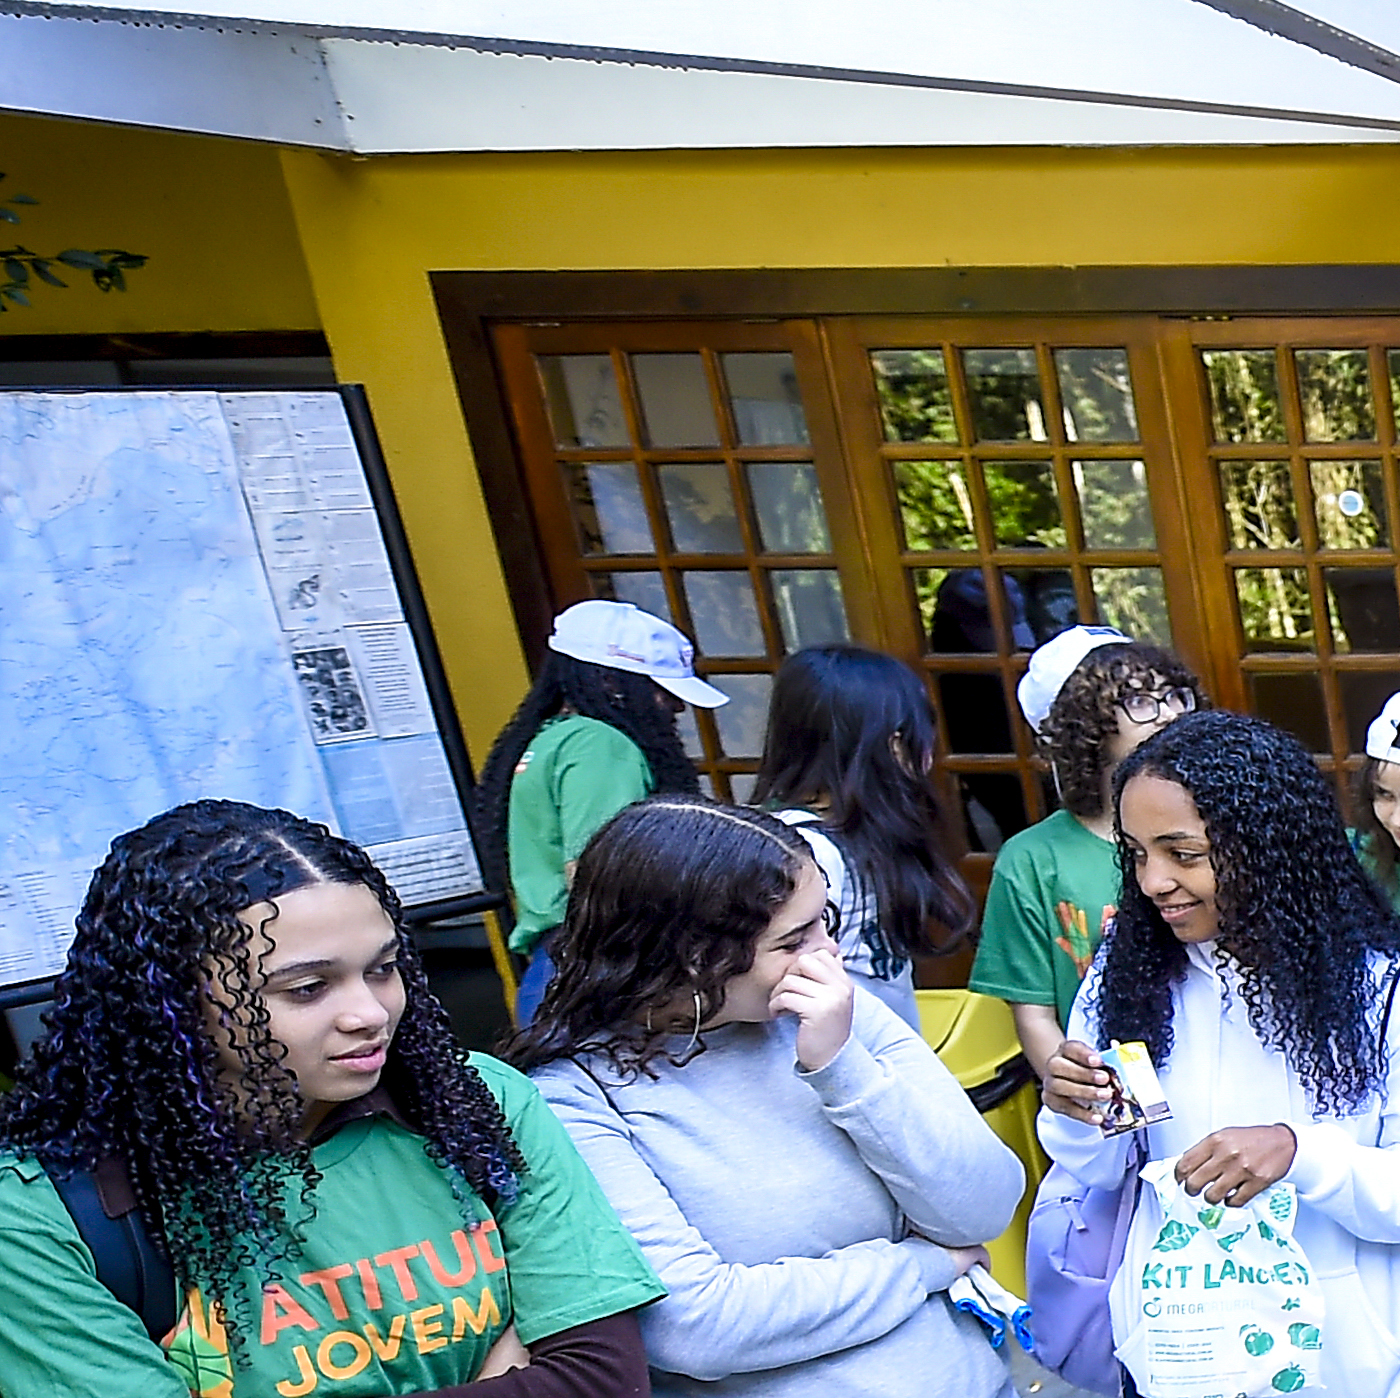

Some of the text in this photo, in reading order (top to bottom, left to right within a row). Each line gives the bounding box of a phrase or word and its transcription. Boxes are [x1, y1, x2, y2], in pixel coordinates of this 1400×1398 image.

[259, 1218, 506, 1346] ATITUD
[1141, 1261, 1193, 1290] KIT
[276, 1286, 501, 1398] JOVEM
